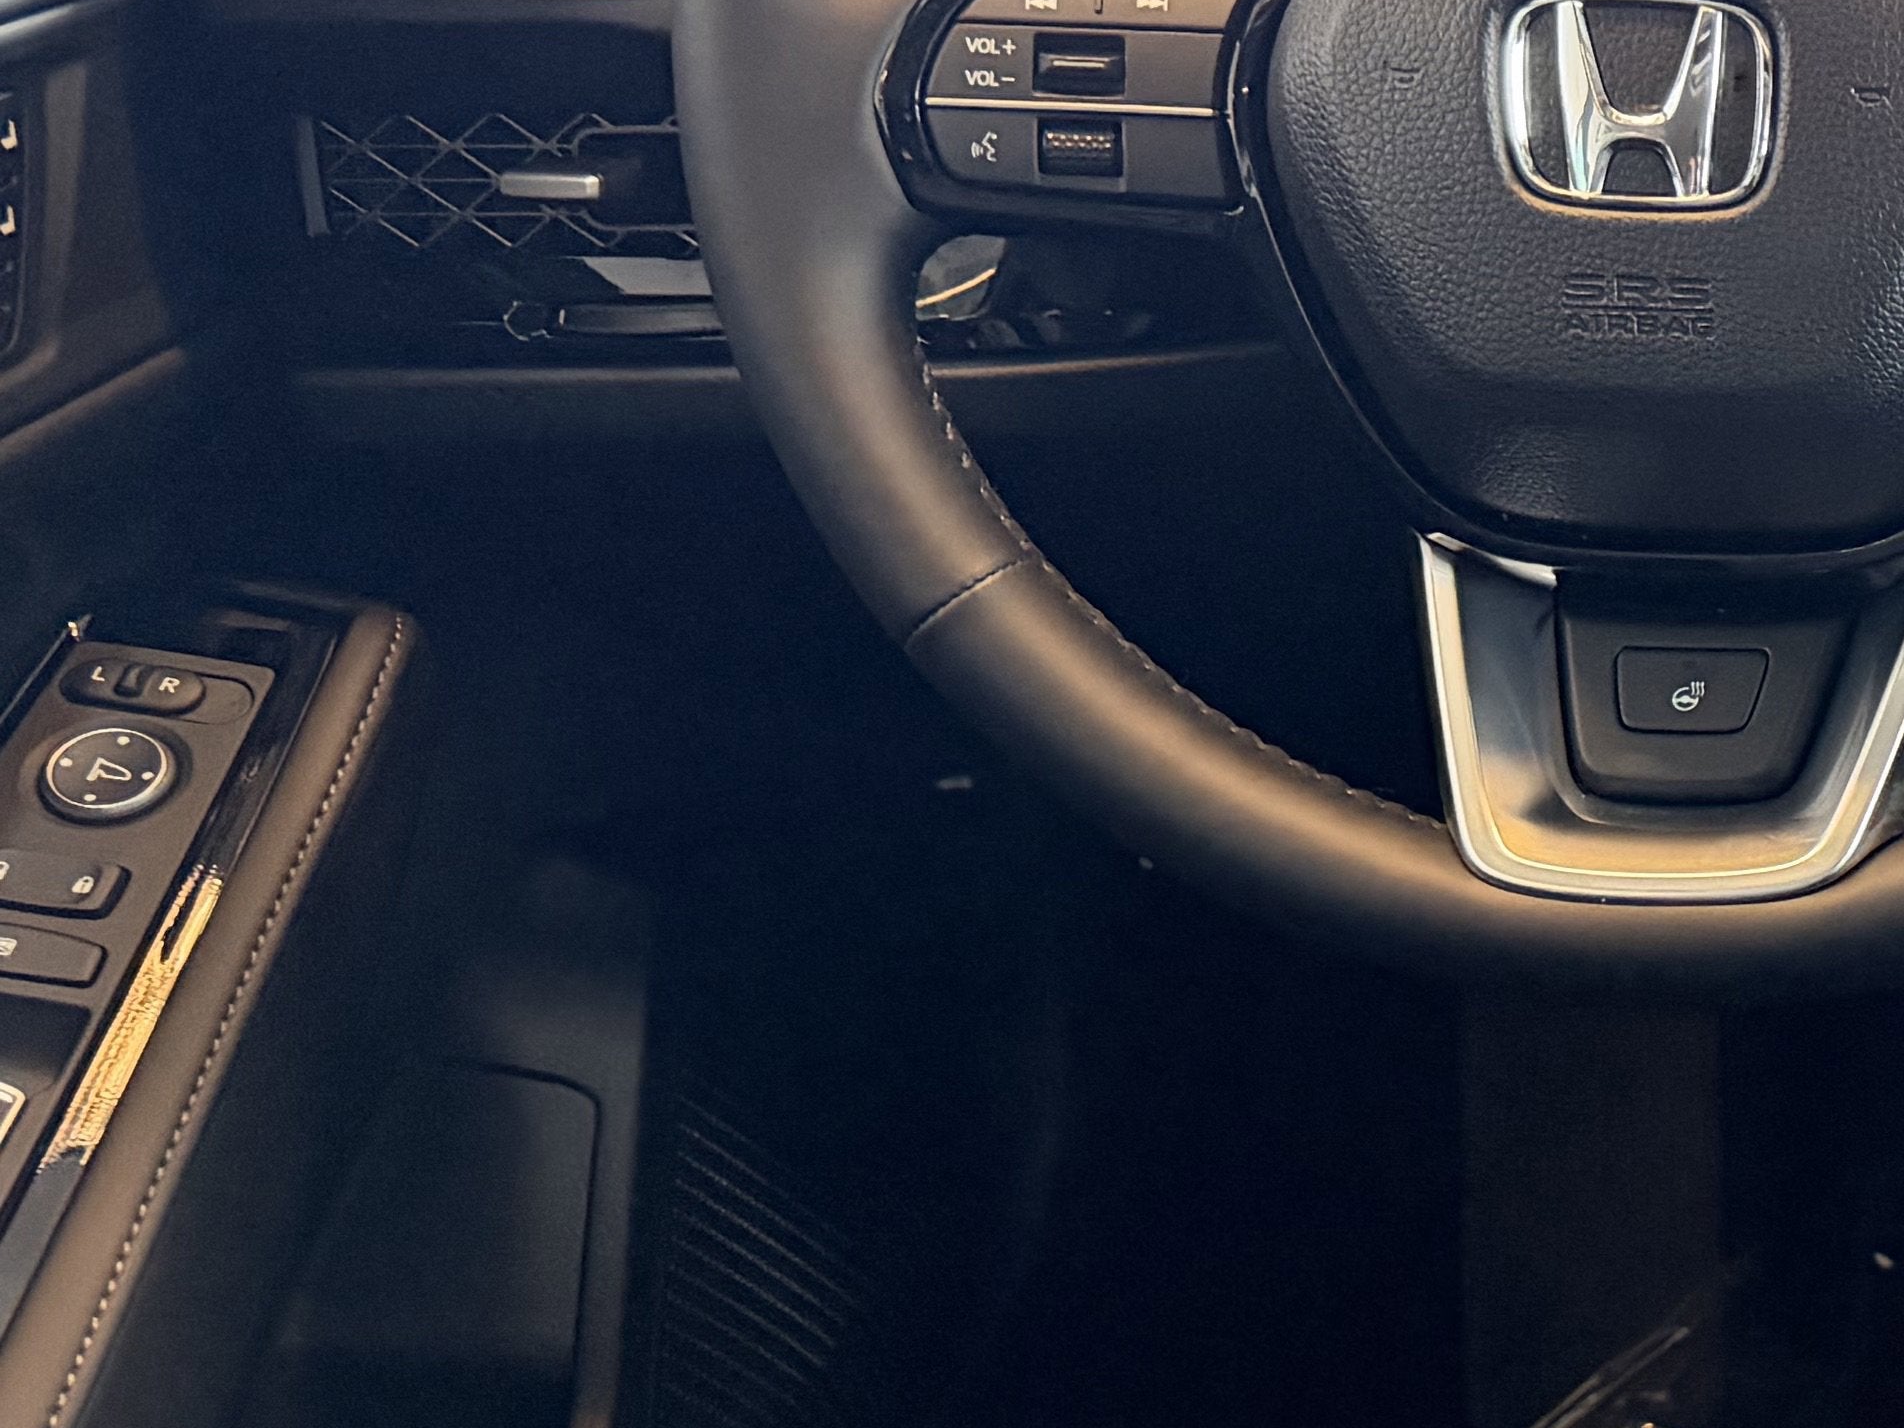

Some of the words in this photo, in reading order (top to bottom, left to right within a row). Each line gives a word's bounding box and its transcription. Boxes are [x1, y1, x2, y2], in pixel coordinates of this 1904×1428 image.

[1562, 273, 1713, 308] SRS
[91, 666, 105, 682] L
[158, 676, 180, 694] R
